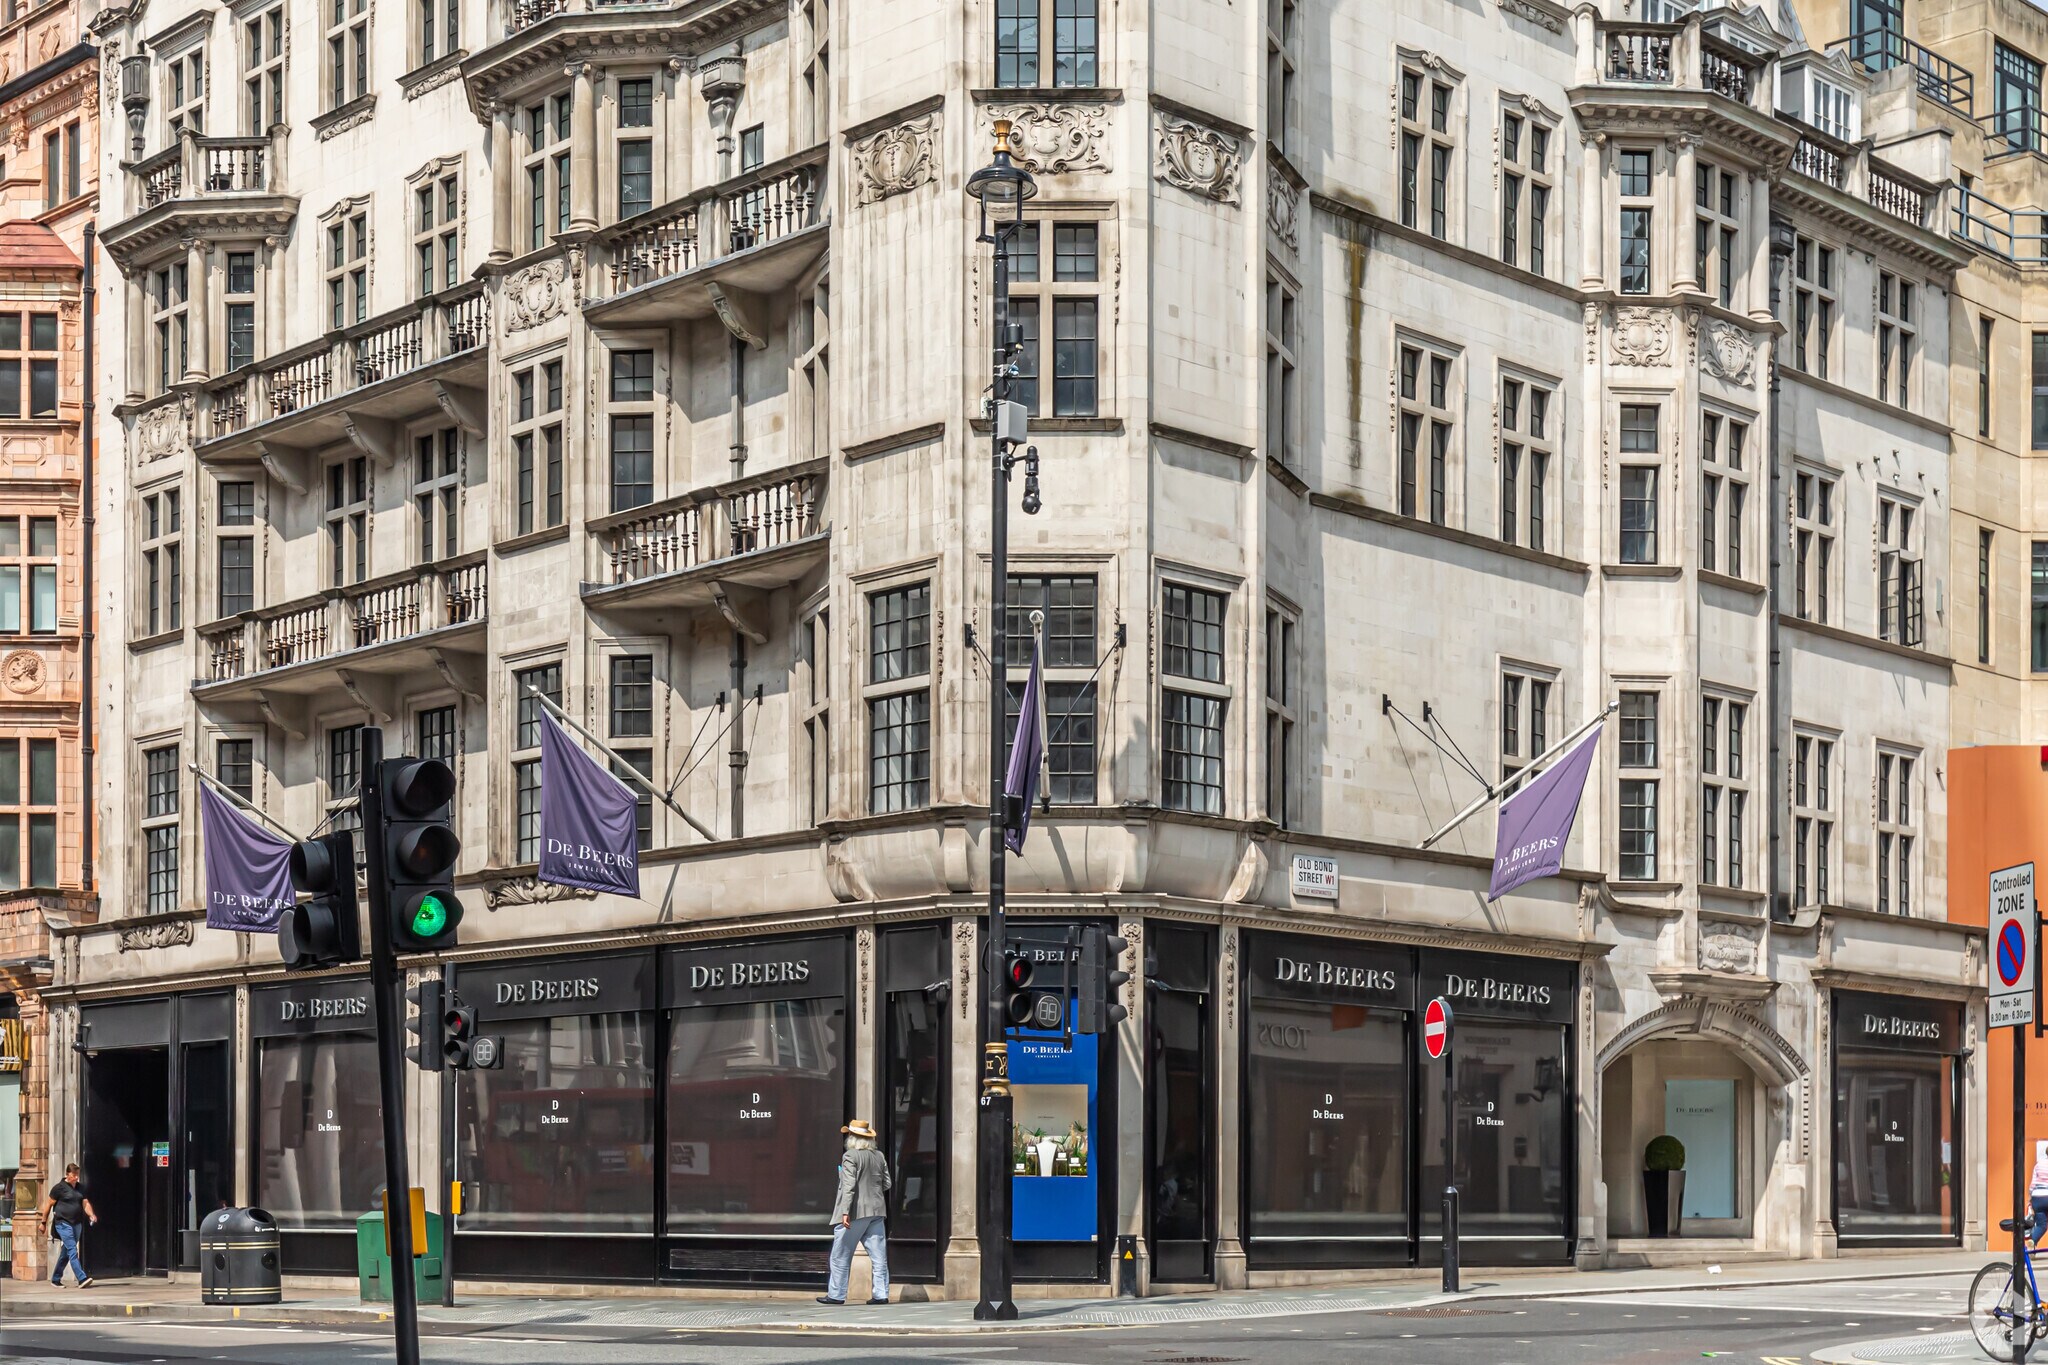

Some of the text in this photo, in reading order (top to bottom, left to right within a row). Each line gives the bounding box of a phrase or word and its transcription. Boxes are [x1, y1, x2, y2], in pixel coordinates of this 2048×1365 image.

[547, 838, 634, 868] DE BEERS
[1512, 836, 1559, 862] BEERS
[1298, 858, 1332, 872] OLD BOND
[1298, 872, 1334, 885] STREET W1
[1993, 871, 2030, 892] Controlled
[214, 892, 292, 909] DE BEERS
[1998, 893, 2024, 914] ZONE
[690, 960, 809, 988] DE BEERS
[1275, 957, 1396, 990] DE BEERS
[496, 978, 599, 1004] DE BEERS
[1446, 974, 1550, 1004] DE BEERS
[281, 997, 366, 1020] DE BEERS
[2000, 1000, 2010, 1008] Mon
[2013, 998, 2021, 1006] Sat
[2012, 1010, 2023, 1019] 6.30
[2024, 1010, 2030, 1019] pm
[1864, 1014, 1939, 1038] DE BEERS
[552, 1100, 559, 1110] D
[752, 1093, 760, 1103] D
[980, 1096, 991, 1105] 67
[1326, 1094, 1332, 1104] D
[1488, 1102, 1494, 1111] D
[327, 1110, 333, 1119] D
[1893, 1121, 1897, 1130] D
